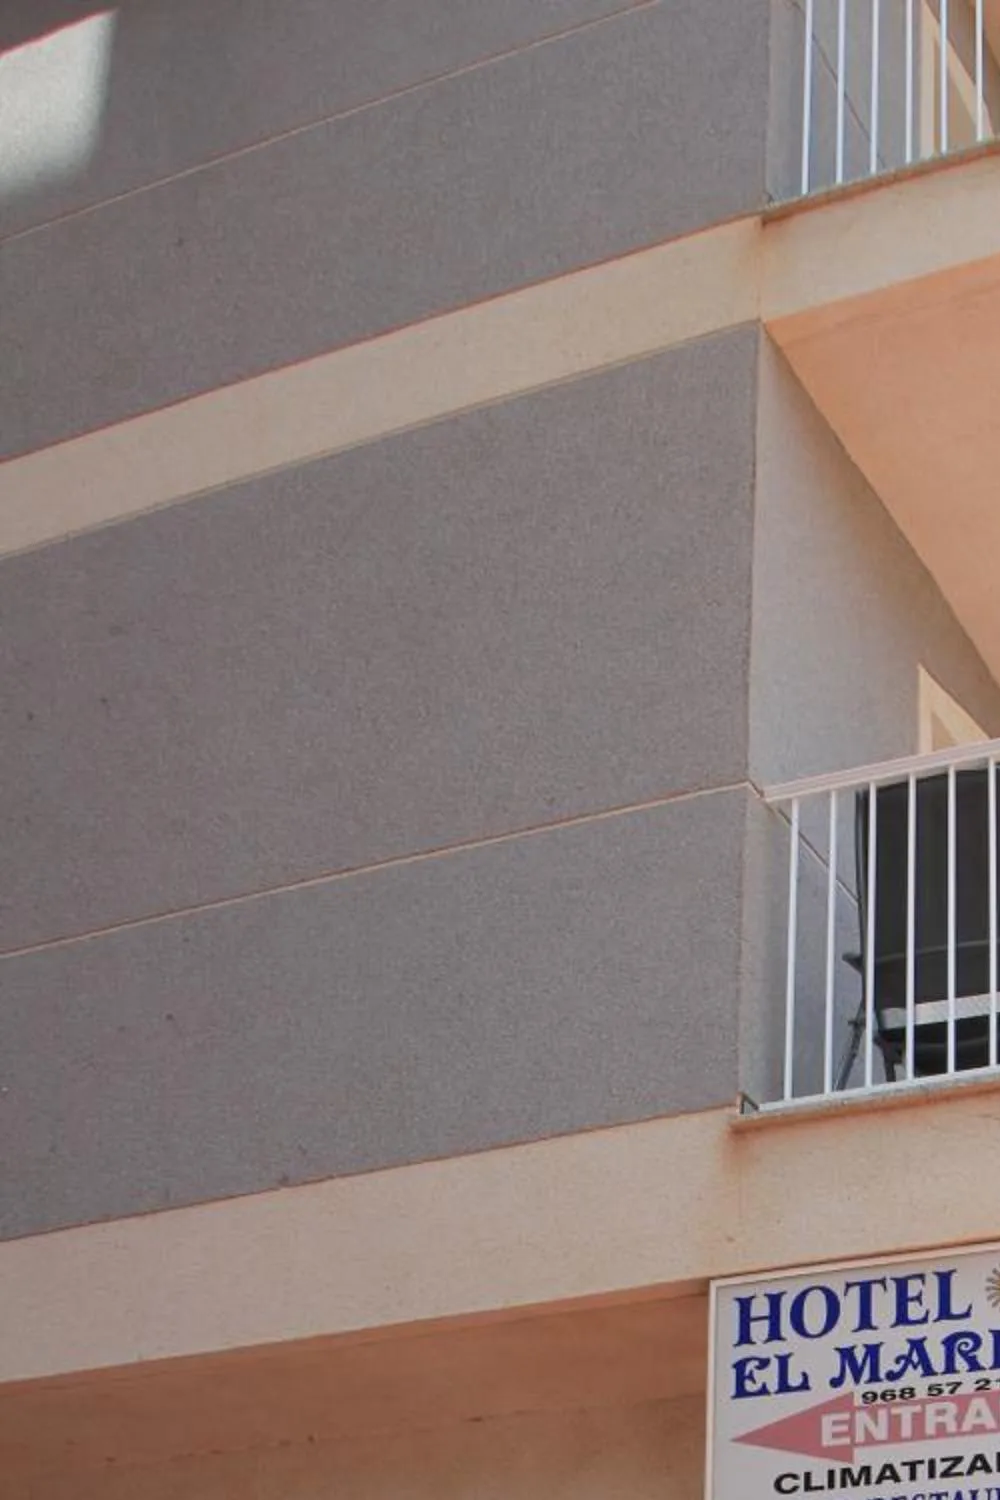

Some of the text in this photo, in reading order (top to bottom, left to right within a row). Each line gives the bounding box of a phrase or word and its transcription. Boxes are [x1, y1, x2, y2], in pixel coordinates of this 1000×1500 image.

[734, 1269, 973, 1347] HOTEL
[730, 1353, 811, 1399] EL
[861, 1386, 917, 1405] 968
[926, 1381, 963, 1397] 57
